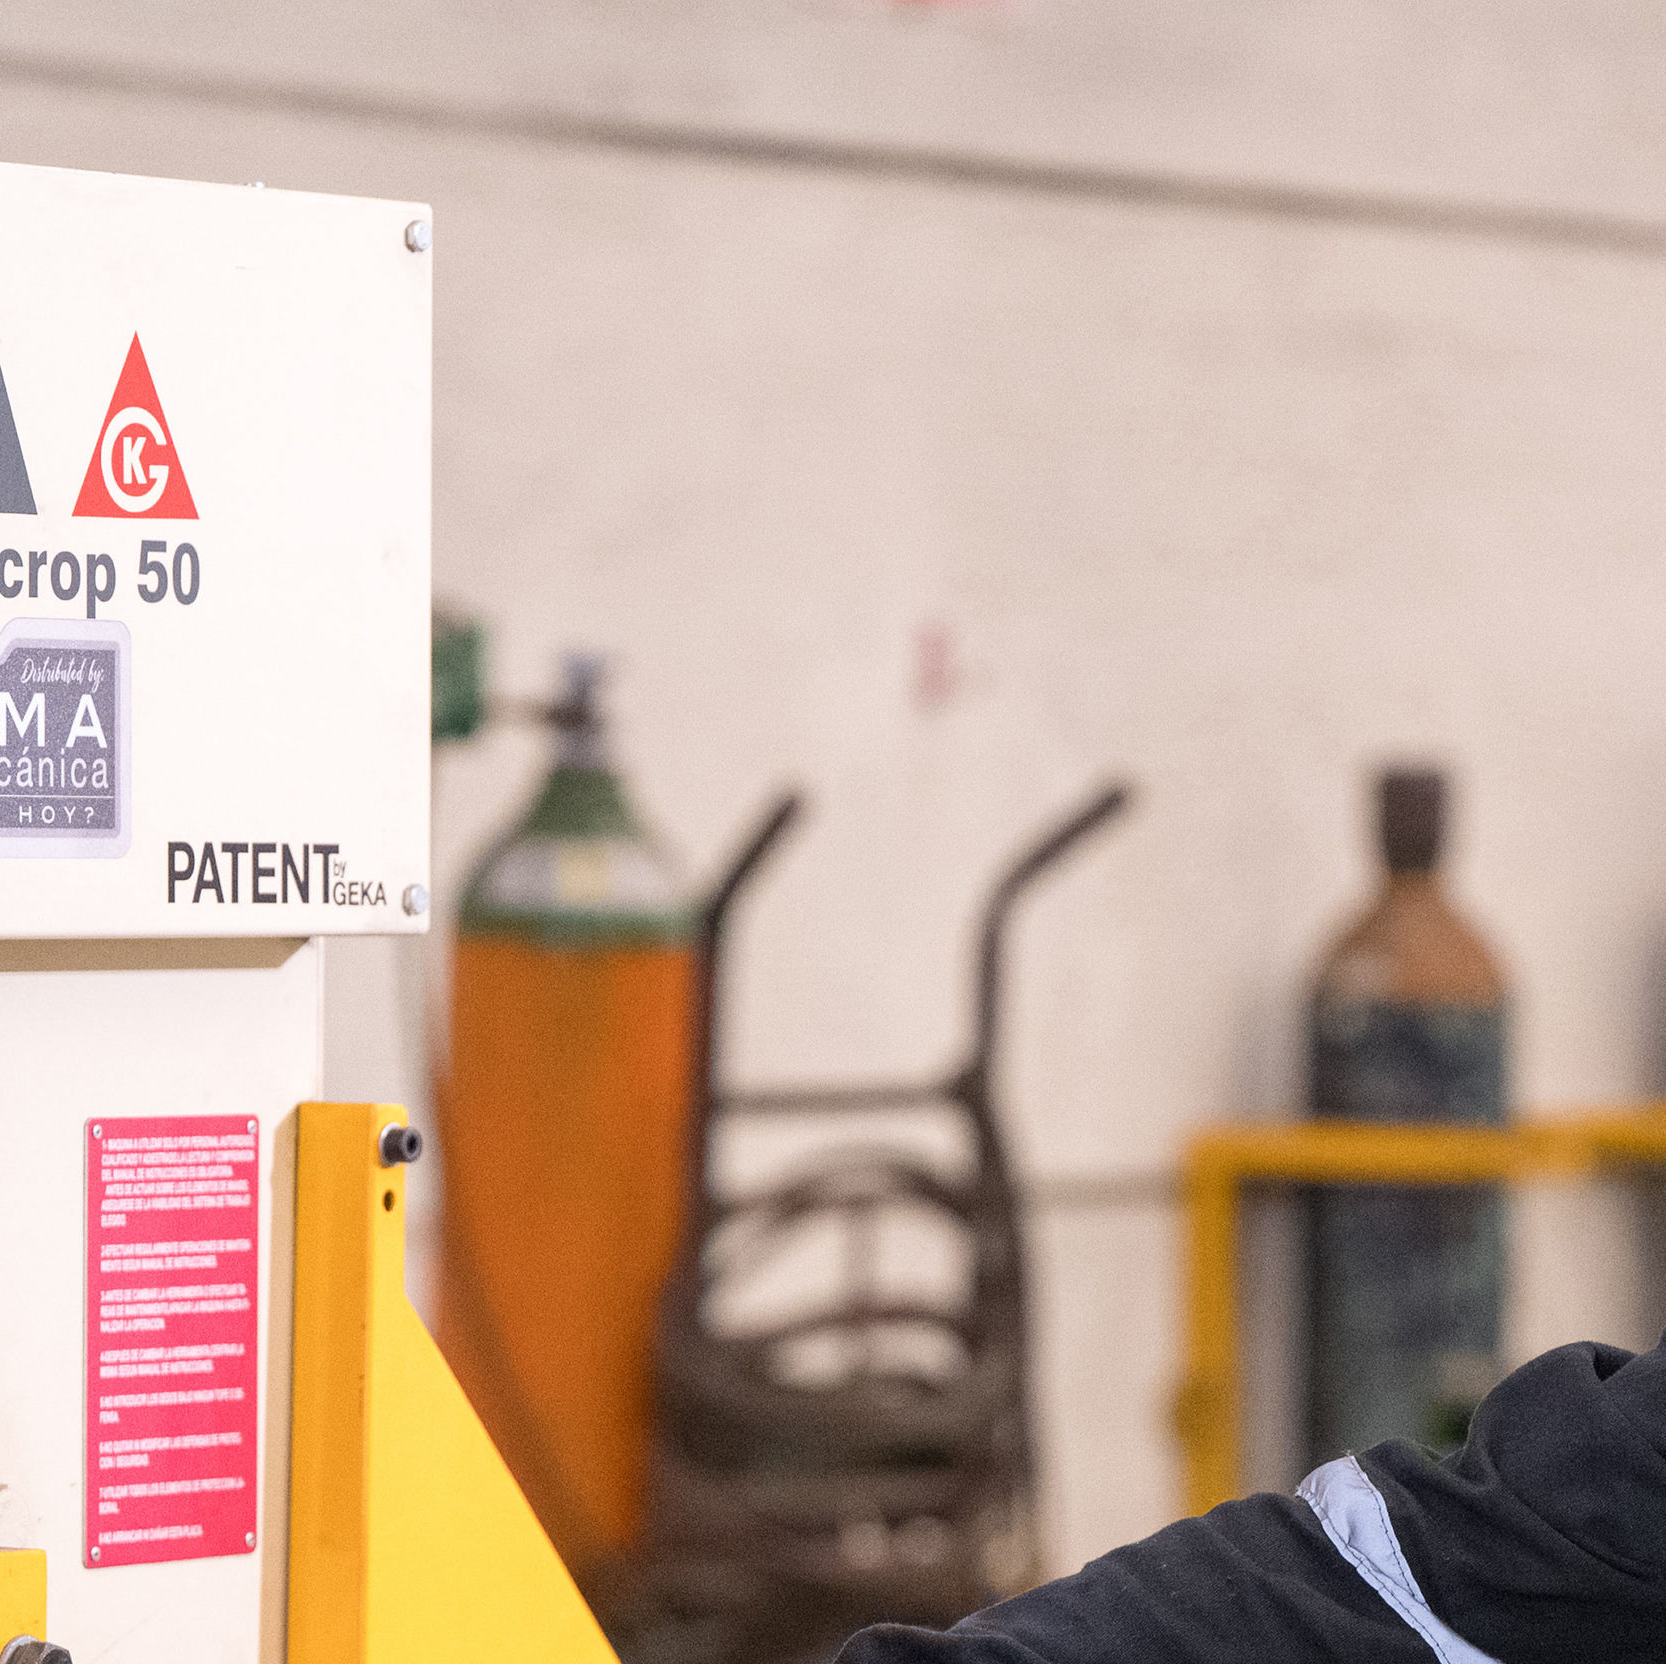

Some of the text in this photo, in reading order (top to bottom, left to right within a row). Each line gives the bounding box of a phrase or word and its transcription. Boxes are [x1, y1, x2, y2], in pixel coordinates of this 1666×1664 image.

[137, 540, 201, 606] 50
[20, 656, 86, 684] Distributed
[18, 804, 96, 825] HOY?
[167, 841, 339, 904] PATENT
[334, 861, 347, 878] by
[332, 881, 388, 907] GEKA
